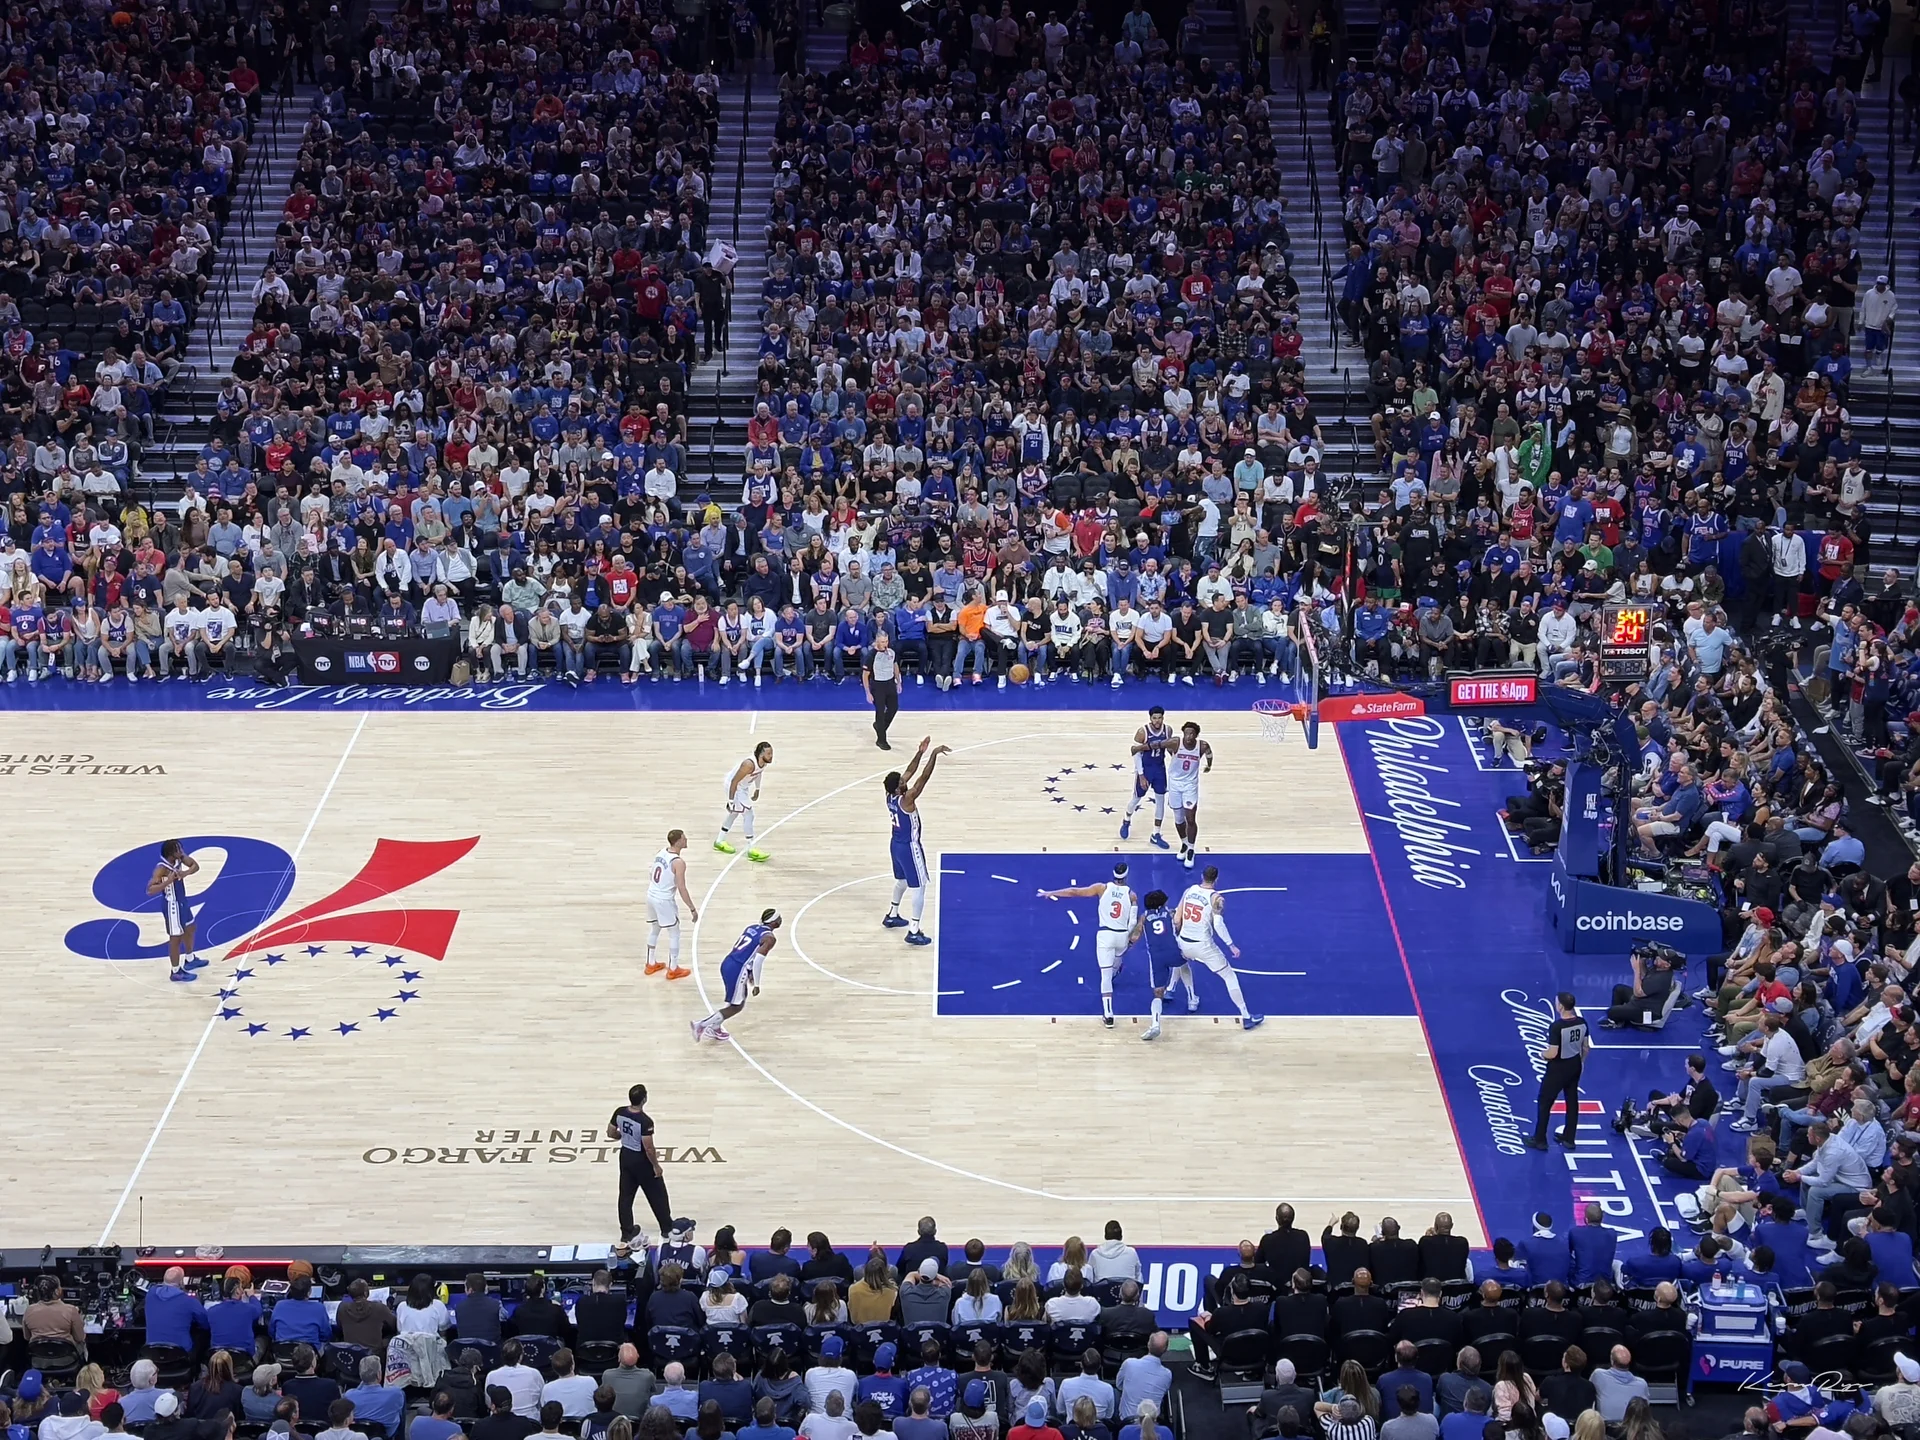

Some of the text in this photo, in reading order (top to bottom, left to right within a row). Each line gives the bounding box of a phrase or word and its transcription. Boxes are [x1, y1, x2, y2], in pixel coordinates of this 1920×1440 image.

[1726, 451, 1743, 459] PHILA
[1034, 540, 1039, 548] 0
[1378, 554, 1383, 565] 0
[1532, 565, 1545, 573] 34
[139, 588, 146, 598] 6
[1614, 625, 1638, 641] 24
[1616, 647, 1648, 655] TISSOT
[348, 655, 366, 669] NBA
[1458, 682, 1528, 700] GET THE App
[1366, 701, 1417, 714] State Farm
[1151, 748, 1160, 758] 12
[28, 764, 168, 776] WELLS
[1182, 760, 1191, 771] 8
[1365, 715, 1481, 890] Philadelphia
[653, 866, 662, 884] 0
[1110, 900, 1122, 919] 3
[1183, 902, 1204, 922] 55
[1152, 920, 1164, 934] 9
[1576, 911, 1684, 931] coinbase
[1569, 1029, 1581, 1043] 29
[362, 1147, 537, 1164] FARGO
[1441, 1292, 1473, 1307] PLAYOFFS
[1719, 1359, 1764, 1370] PURE
